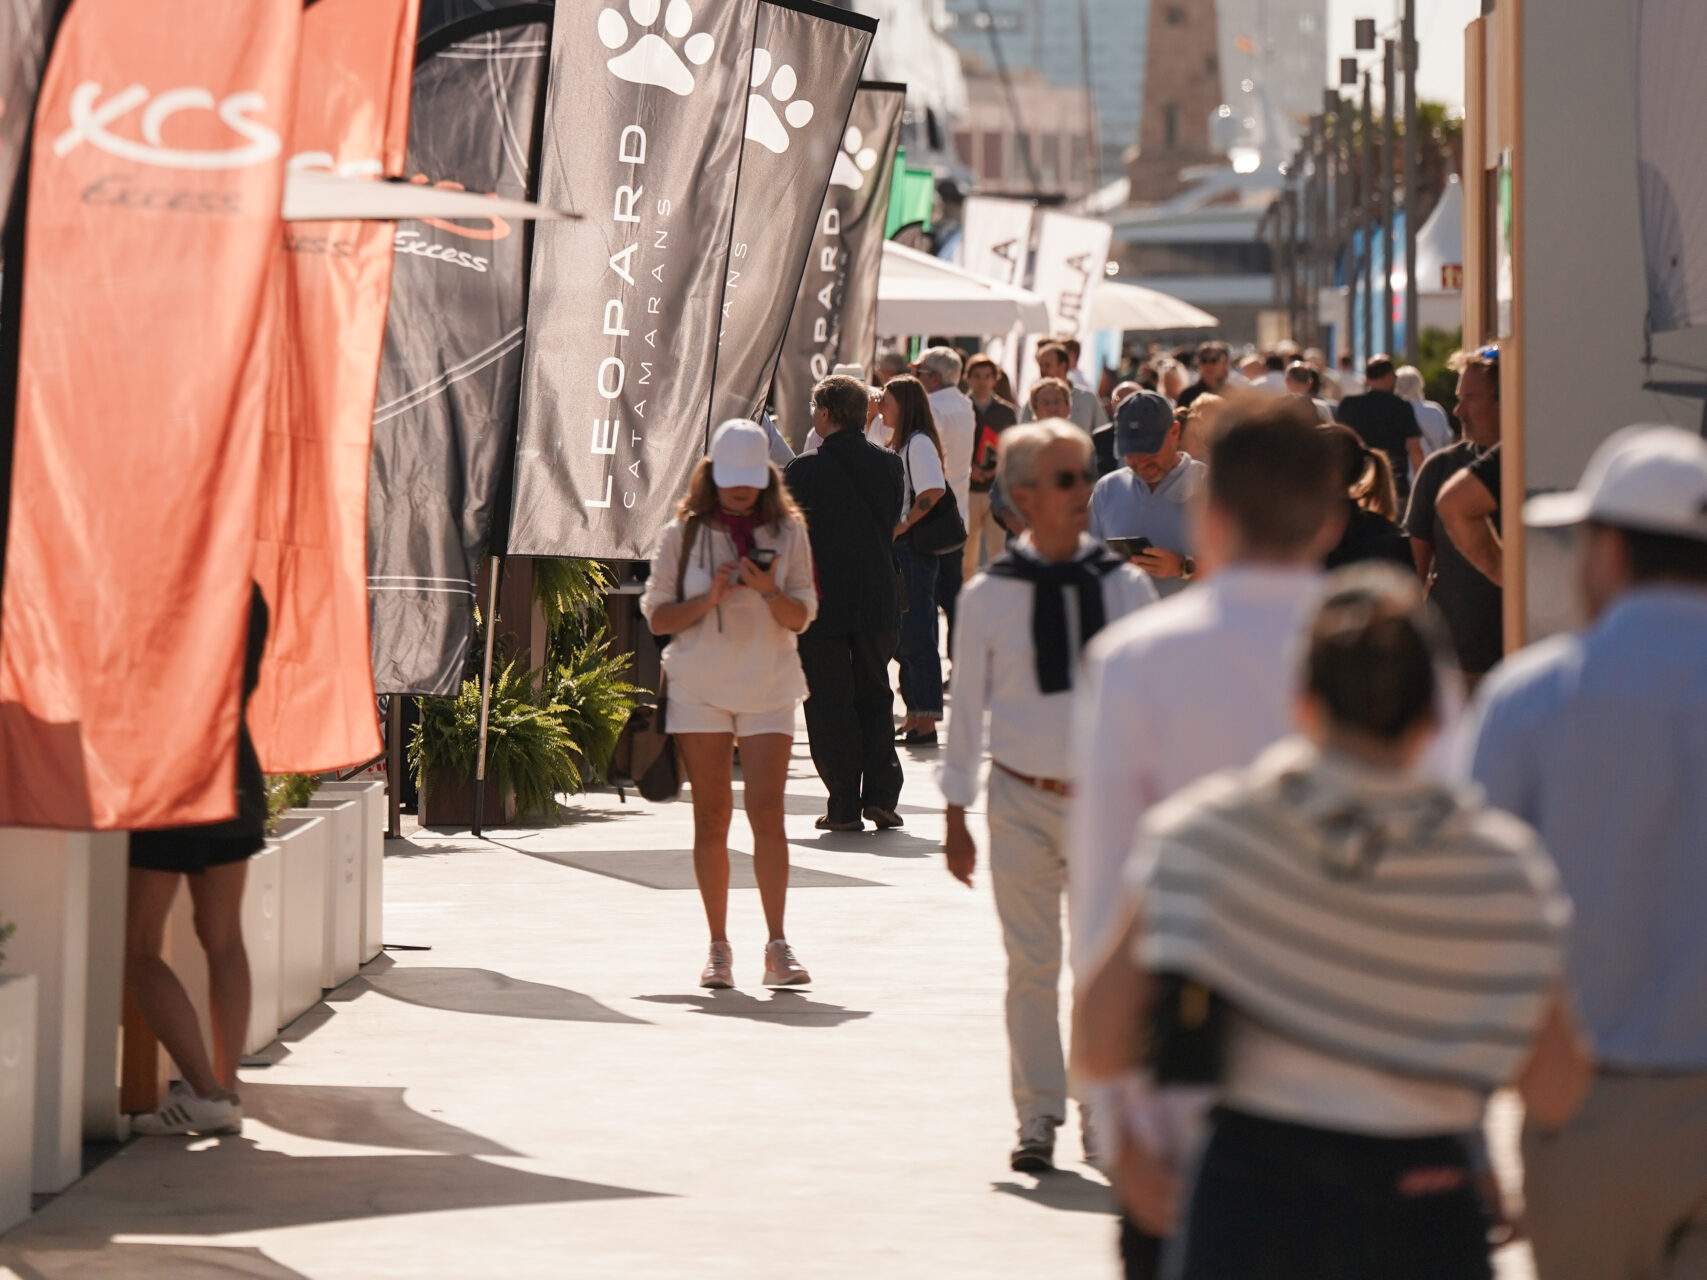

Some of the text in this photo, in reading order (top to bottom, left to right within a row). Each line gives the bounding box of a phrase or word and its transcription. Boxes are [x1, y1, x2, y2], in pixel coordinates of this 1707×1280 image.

[394, 230, 489, 273] Excess
[584, 124, 647, 509] LEOPARD
[719, 242, 748, 345] ANS
[810, 208, 840, 381] OPARD
[623, 198, 671, 509] CATAMARANS
